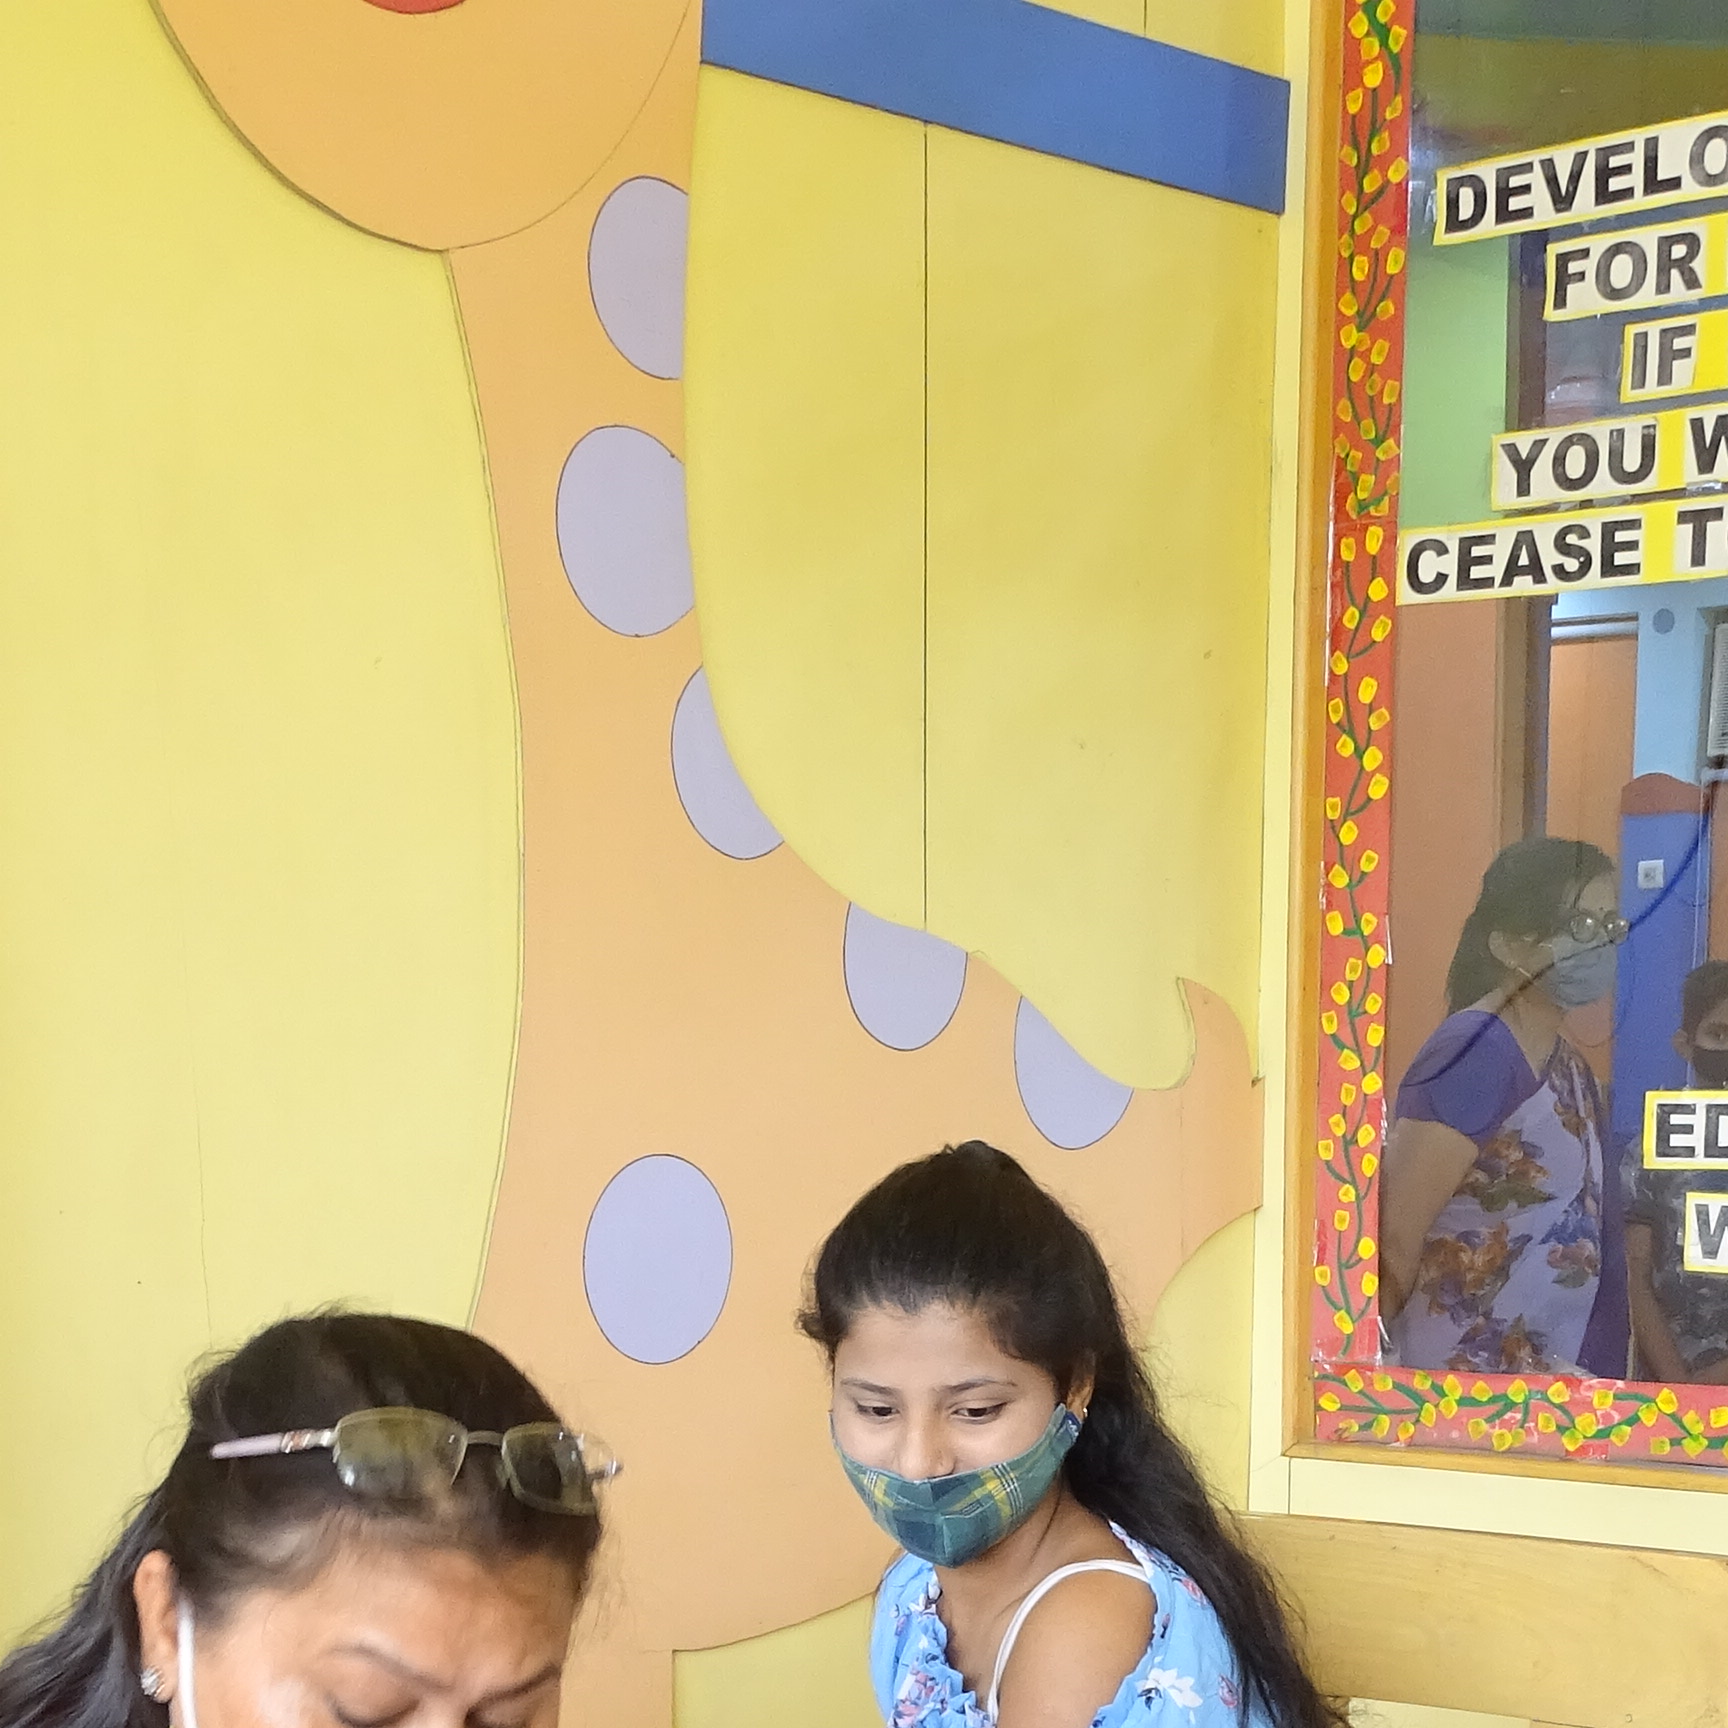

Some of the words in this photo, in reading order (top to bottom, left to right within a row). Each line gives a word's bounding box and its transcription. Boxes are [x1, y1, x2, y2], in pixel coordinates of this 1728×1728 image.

[1551, 232, 1702, 311] FOR
[1631, 322, 1696, 391] IF
[1501, 423, 1657, 498] YOU
[1405, 517, 1643, 595] CEASE
